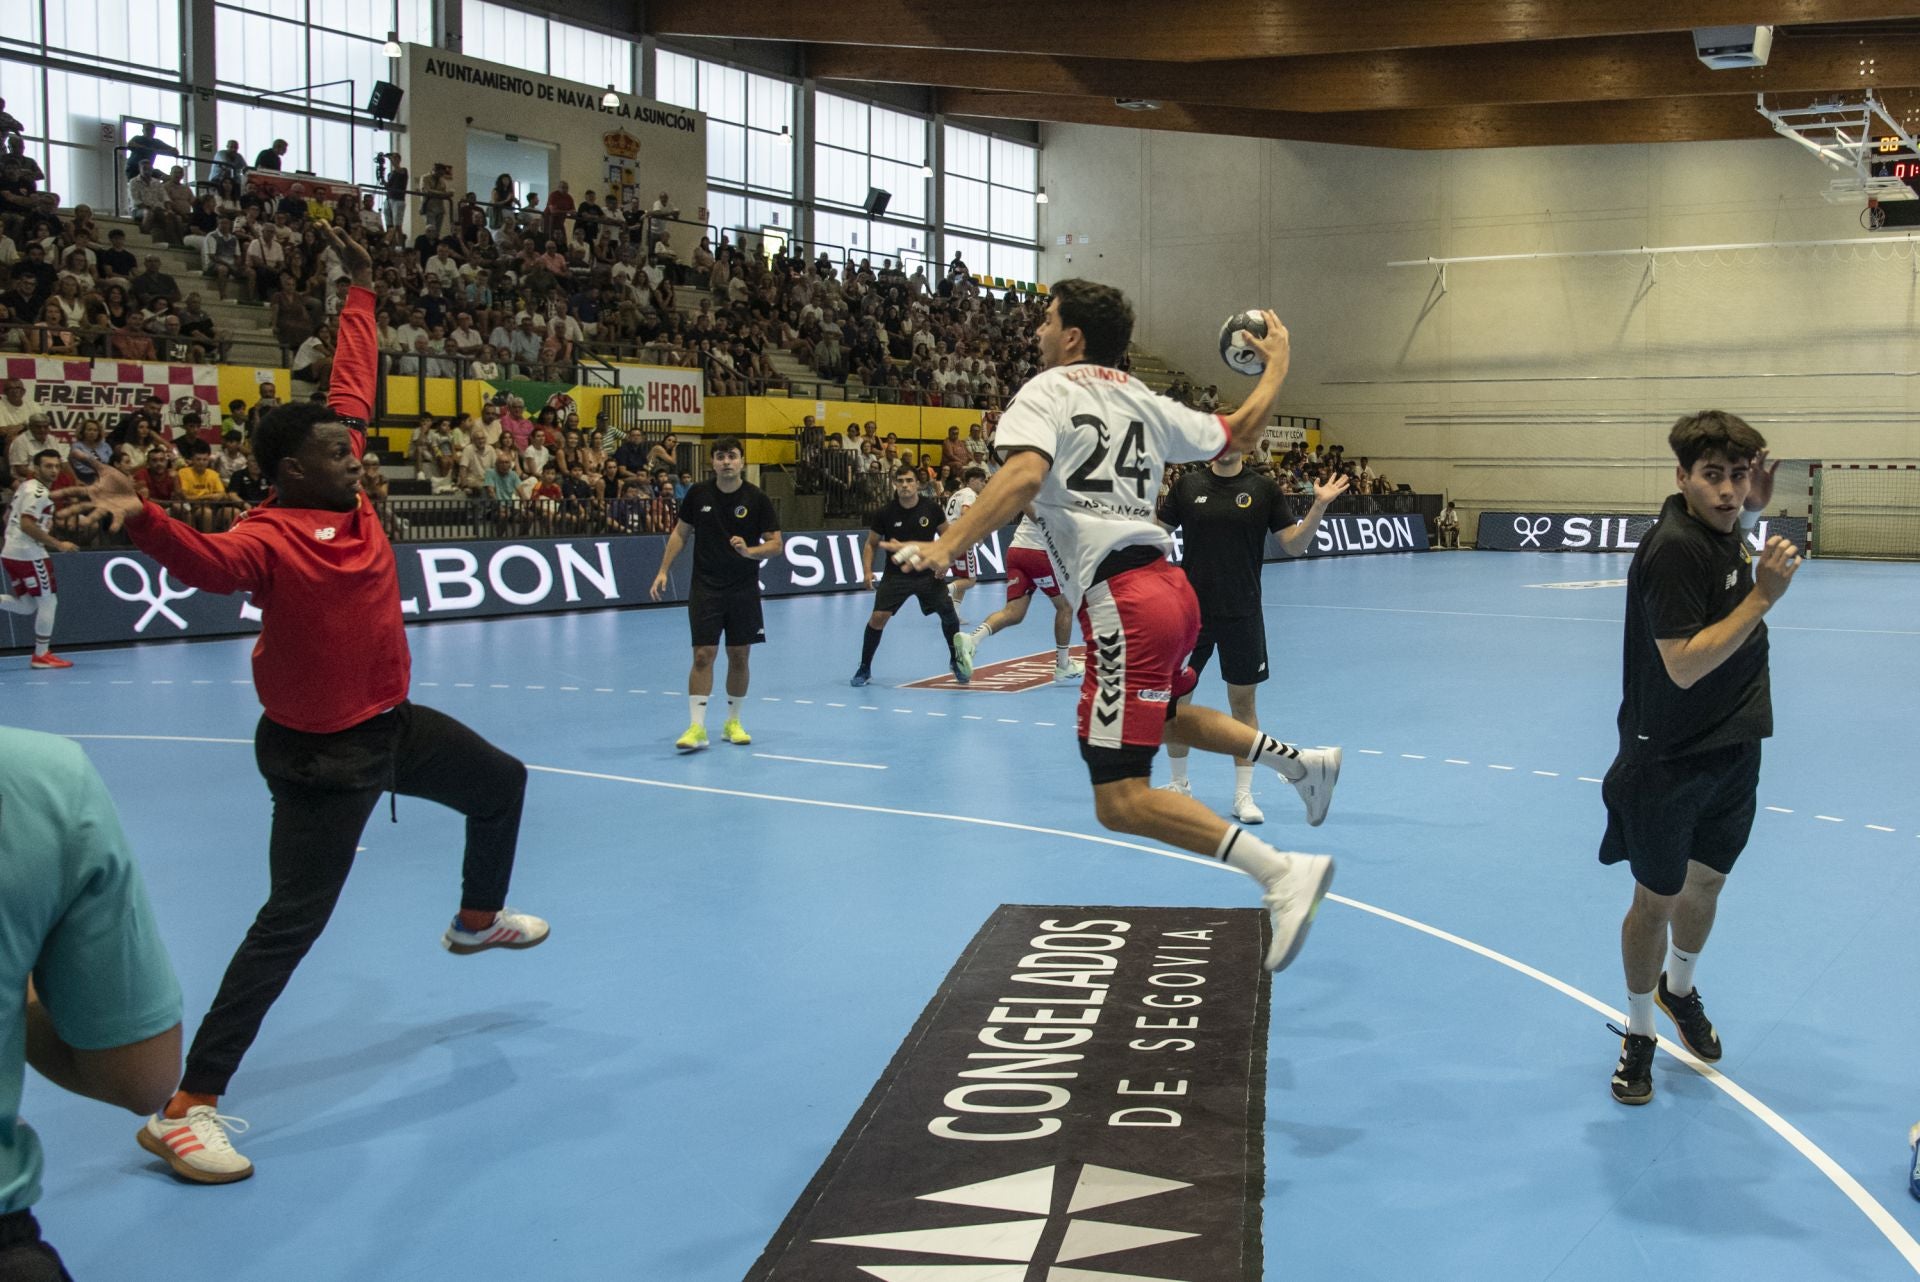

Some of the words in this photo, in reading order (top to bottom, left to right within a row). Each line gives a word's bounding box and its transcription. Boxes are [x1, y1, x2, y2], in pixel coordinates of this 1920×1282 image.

[425, 58, 534, 96] AYUNTAMIENTO
[537, 84, 554, 102] DE
[557, 89, 595, 111] NAVA
[633, 103, 695, 132] ASUNCIÓN
[34, 384, 152, 406] FRENTE
[648, 381, 701, 414] HEROL
[1066, 413, 1151, 499] 24
[947, 499, 956, 516] 8
[785, 528, 1006, 588] SILN
[1315, 516, 1415, 552] SILBON
[1561, 517, 1768, 551] SILN
[1128, 929, 1214, 1052] SEGOVIA
[927, 919, 1132, 1142] CONGELADOS
[1108, 1079, 1188, 1127] DE
